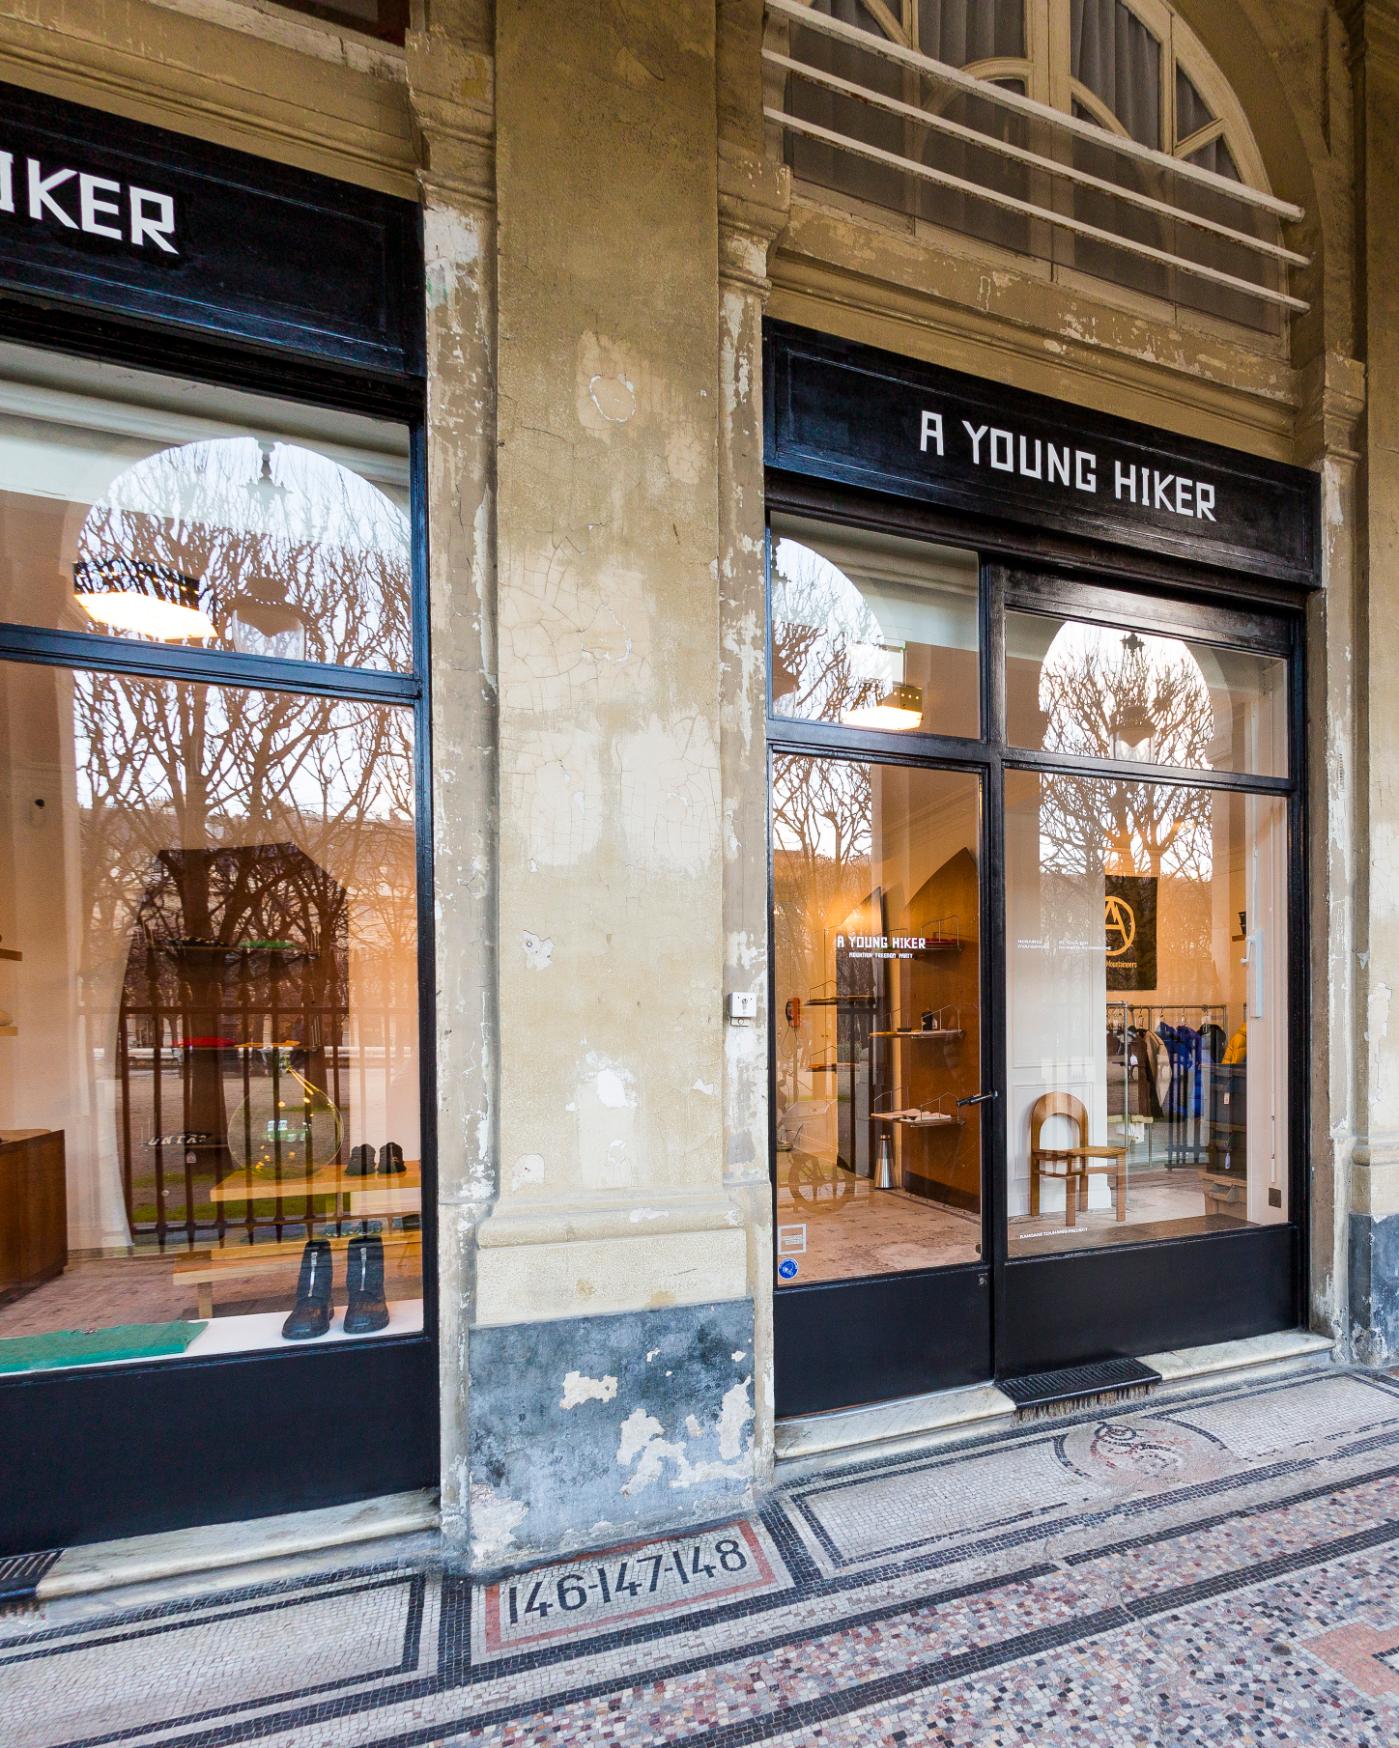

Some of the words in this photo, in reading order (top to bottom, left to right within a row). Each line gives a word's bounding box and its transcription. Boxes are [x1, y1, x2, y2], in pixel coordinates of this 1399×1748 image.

[0, 150, 179, 255] IKER
[920, 410, 944, 456] A
[962, 420, 1097, 493] YOUNG
[1114, 460, 1217, 522] HIKER
[837, 936, 845, 948] A
[848, 936, 888, 948] YOUNG
[892, 937, 926, 949] HIKER
[508, 1538, 747, 1625] 146-147-148
